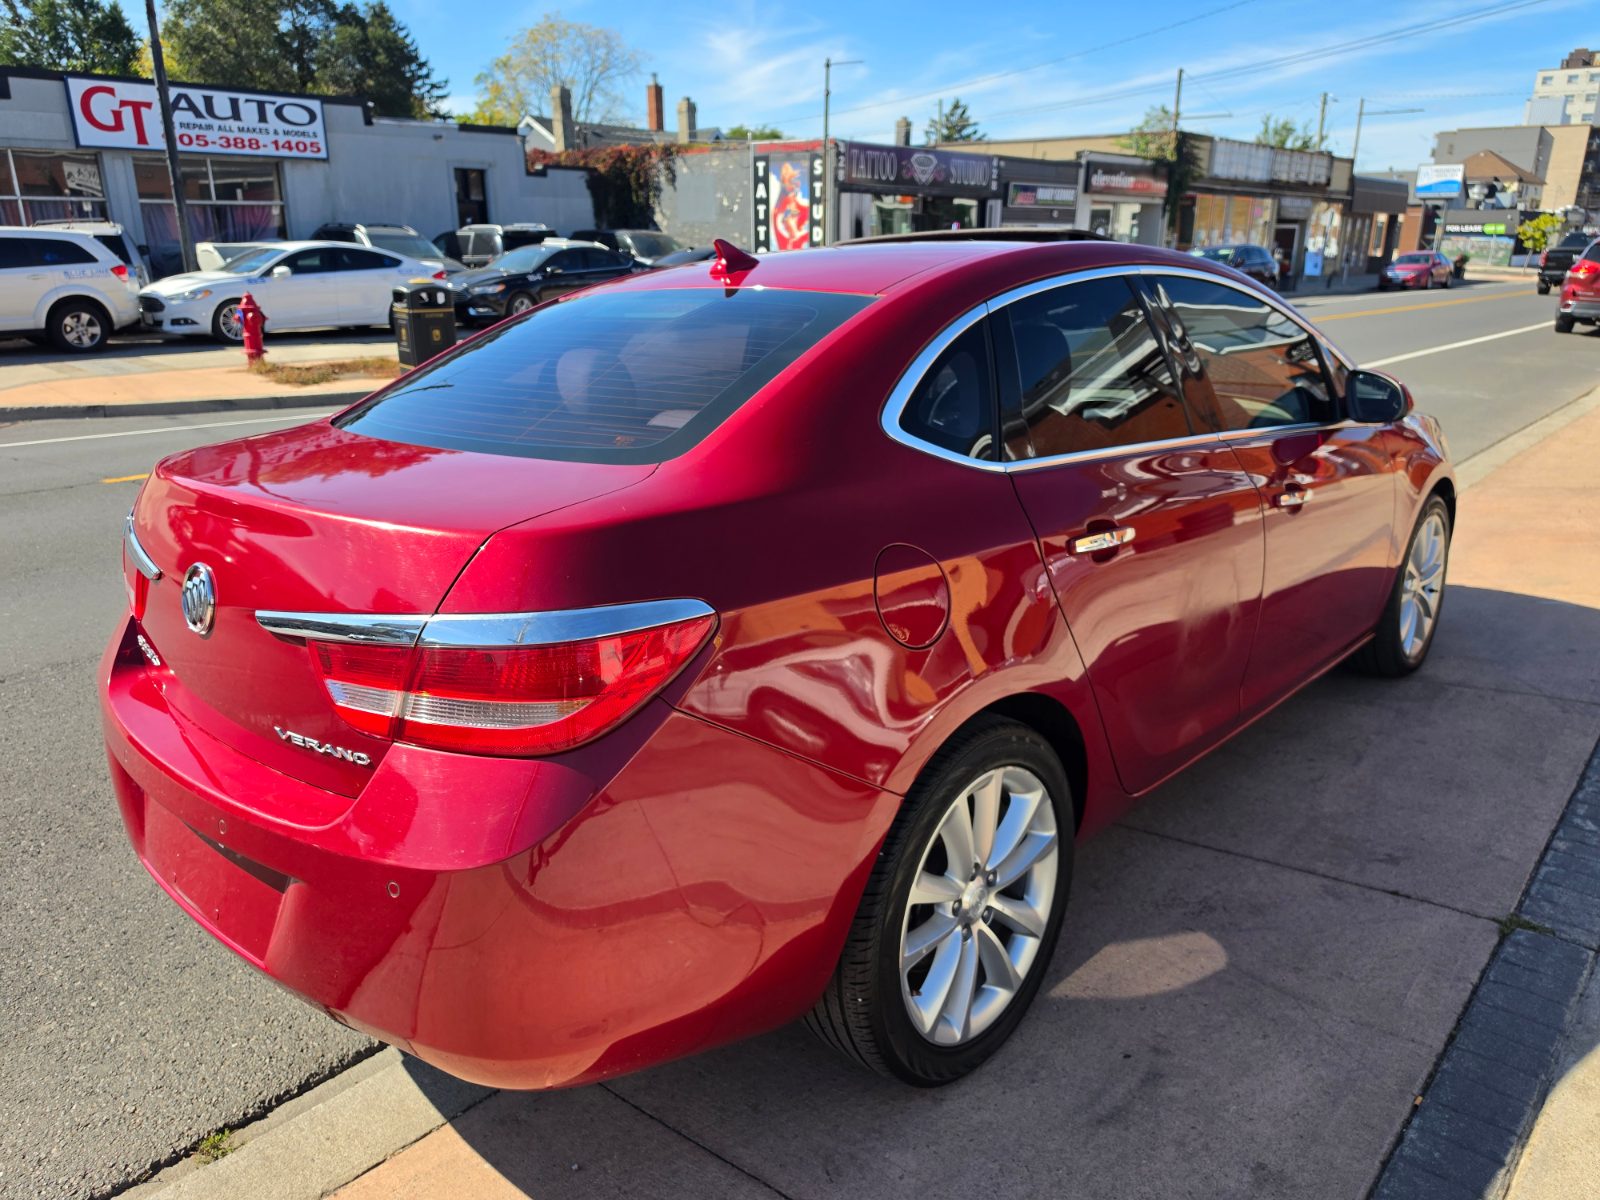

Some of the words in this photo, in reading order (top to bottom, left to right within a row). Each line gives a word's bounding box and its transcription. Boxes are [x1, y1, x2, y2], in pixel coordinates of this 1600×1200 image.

[80, 85, 153, 145] GT
[170, 92, 317, 127] AUTO
[179, 121, 214, 132] REPAIR
[217, 124, 234, 134] ALL
[237, 125, 270, 136] MAKES
[273, 128, 280, 136] &
[283, 128, 319, 139] MODELS
[162, 132, 322, 154] 05-388-1405
[851, 148, 898, 181] TATTOO
[949, 157, 990, 186] STUDIO
[274, 725, 371, 766] VERANO
